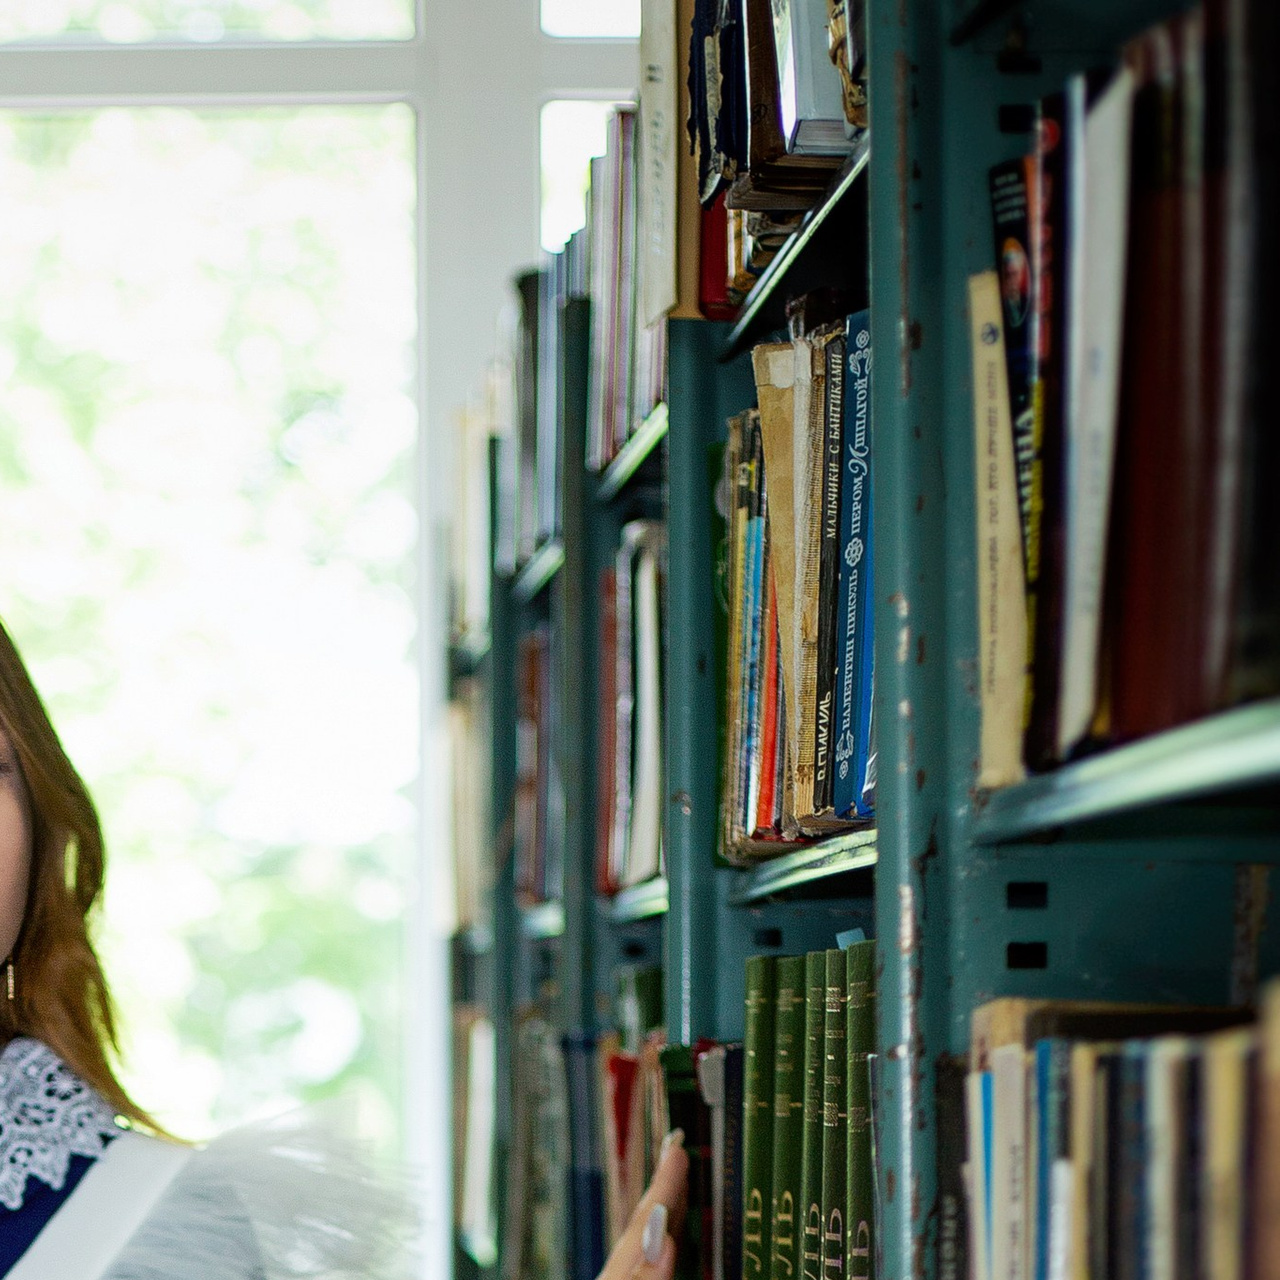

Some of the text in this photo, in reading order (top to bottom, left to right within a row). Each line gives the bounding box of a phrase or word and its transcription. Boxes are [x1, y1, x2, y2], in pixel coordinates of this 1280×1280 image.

[830, 353, 844, 440] БАНТИКАМИ
[852, 378, 869, 447] ШПАГОЙ
[826, 463, 841, 538] МАЛЬЧИКИ
[849, 475, 864, 535] ПЕРОМ
[842, 570, 859, 730] ВАЛЕНТИН ПИКУЛЬ
